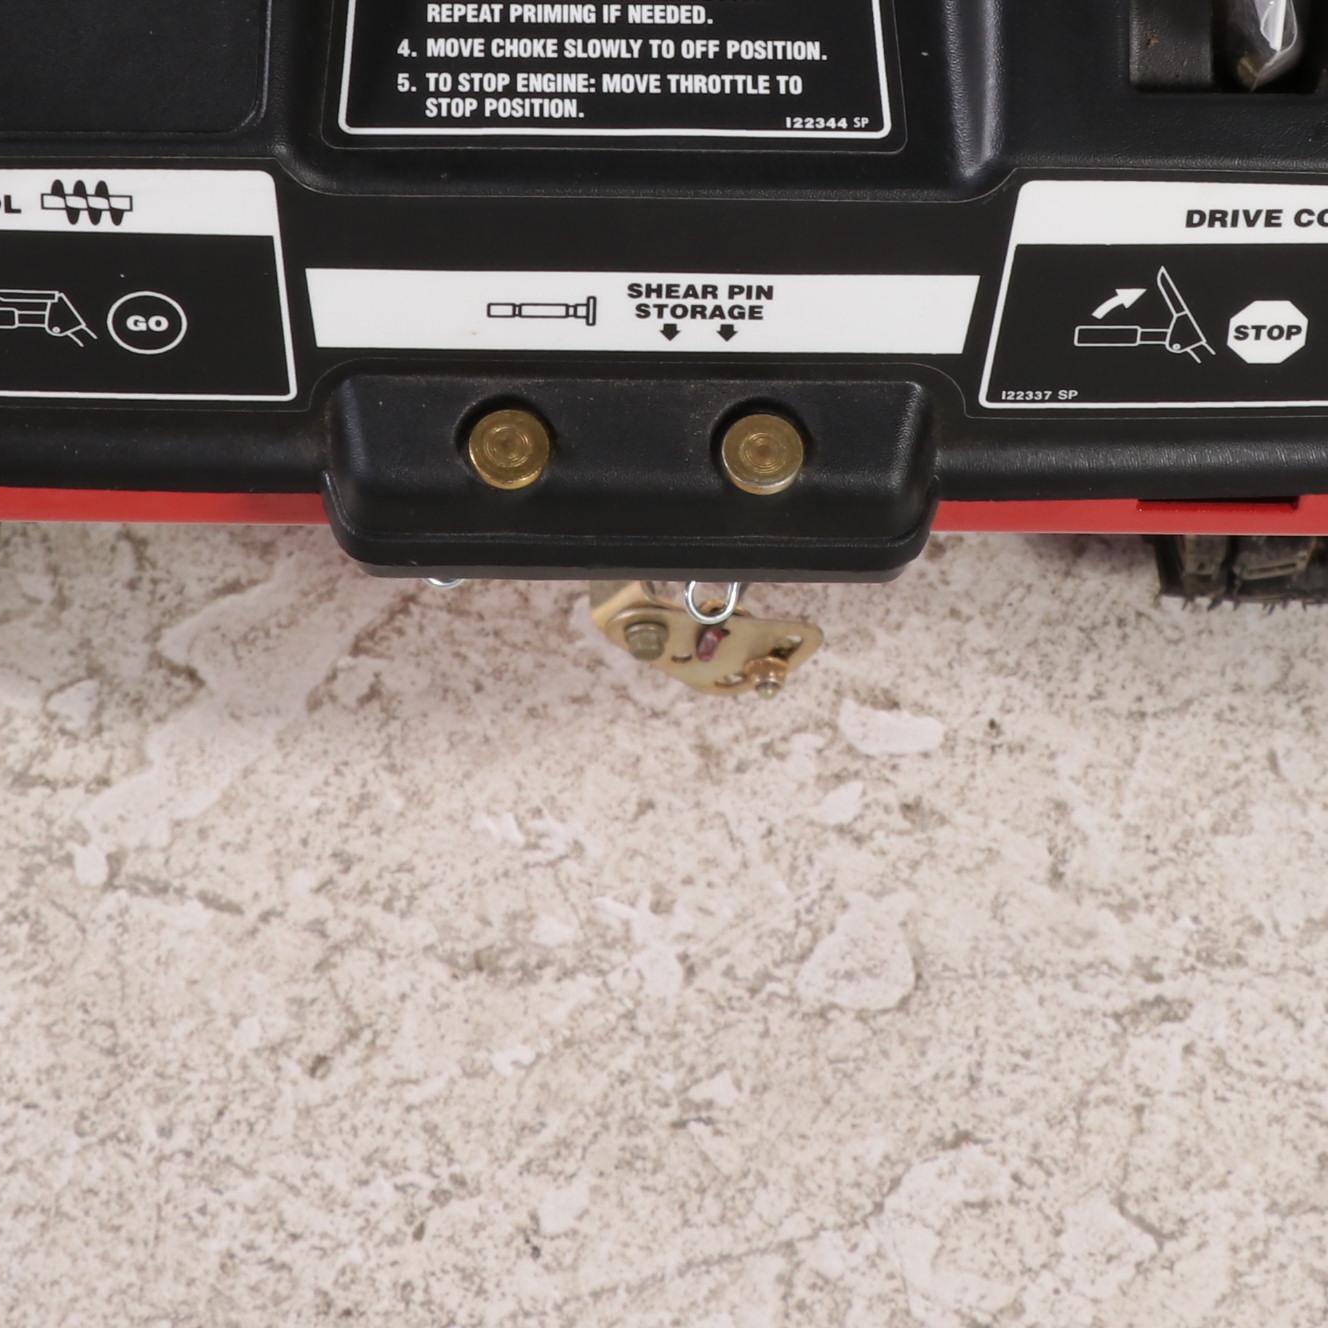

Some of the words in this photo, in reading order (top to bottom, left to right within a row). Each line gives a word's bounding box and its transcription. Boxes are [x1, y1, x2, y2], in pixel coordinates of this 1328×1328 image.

[427, 4, 503, 22] REPEAT
[510, 4, 595, 23] PRIMING
[603, 5, 621, 23] IF
[628, 5, 713, 24] NEEDED.
[397, 39, 417, 57] 4.
[427, 38, 484, 57] MOVE
[492, 39, 557, 57] CHOKE
[564, 39, 642, 58] SLOWLY
[649, 39, 674, 58] TO
[681, 40, 719, 59] OFF
[727, 40, 827, 60] POSITION.
[398, 73, 416, 92] 5.
[426, 73, 452, 92] TO
[458, 73, 510, 92] STOP
[517, 73, 595, 92] ENGINE:
[603, 74, 661, 93] MOVE
[667, 74, 770, 94] THROTTLE
[776, 76, 802, 94] TO
[426, 98, 477, 117] STOP
[485, 98, 584, 118] POSITION.
[853, 117, 869, 128] SP
[1186, 209, 1283, 228] DRIVE
[628, 283, 718, 299] SHEAR
[728, 285, 773, 300] PIN
[636, 303, 763, 320] STORAGE
[127, 315, 168, 331] GO
[1234, 325, 1302, 341] STOP
[1058, 390, 1078, 400] SP
